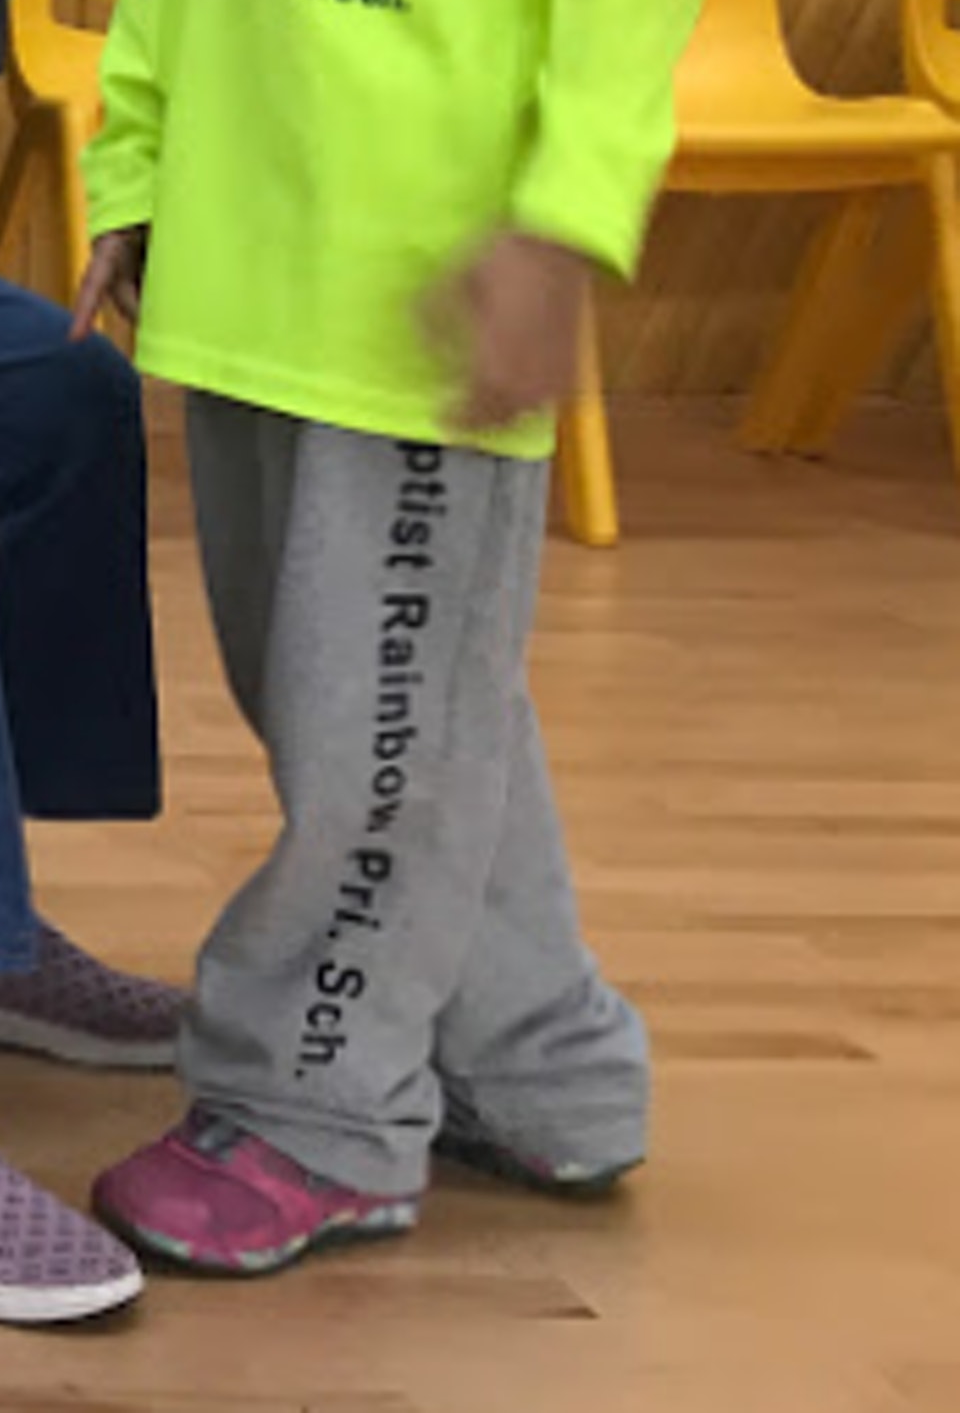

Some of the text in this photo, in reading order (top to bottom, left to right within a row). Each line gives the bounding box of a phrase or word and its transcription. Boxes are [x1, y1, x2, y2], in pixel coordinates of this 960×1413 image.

[366, 594, 430, 833] Rainbow
[327, 848, 392, 939] Pri.
[294, 959, 365, 1079] Sch.
